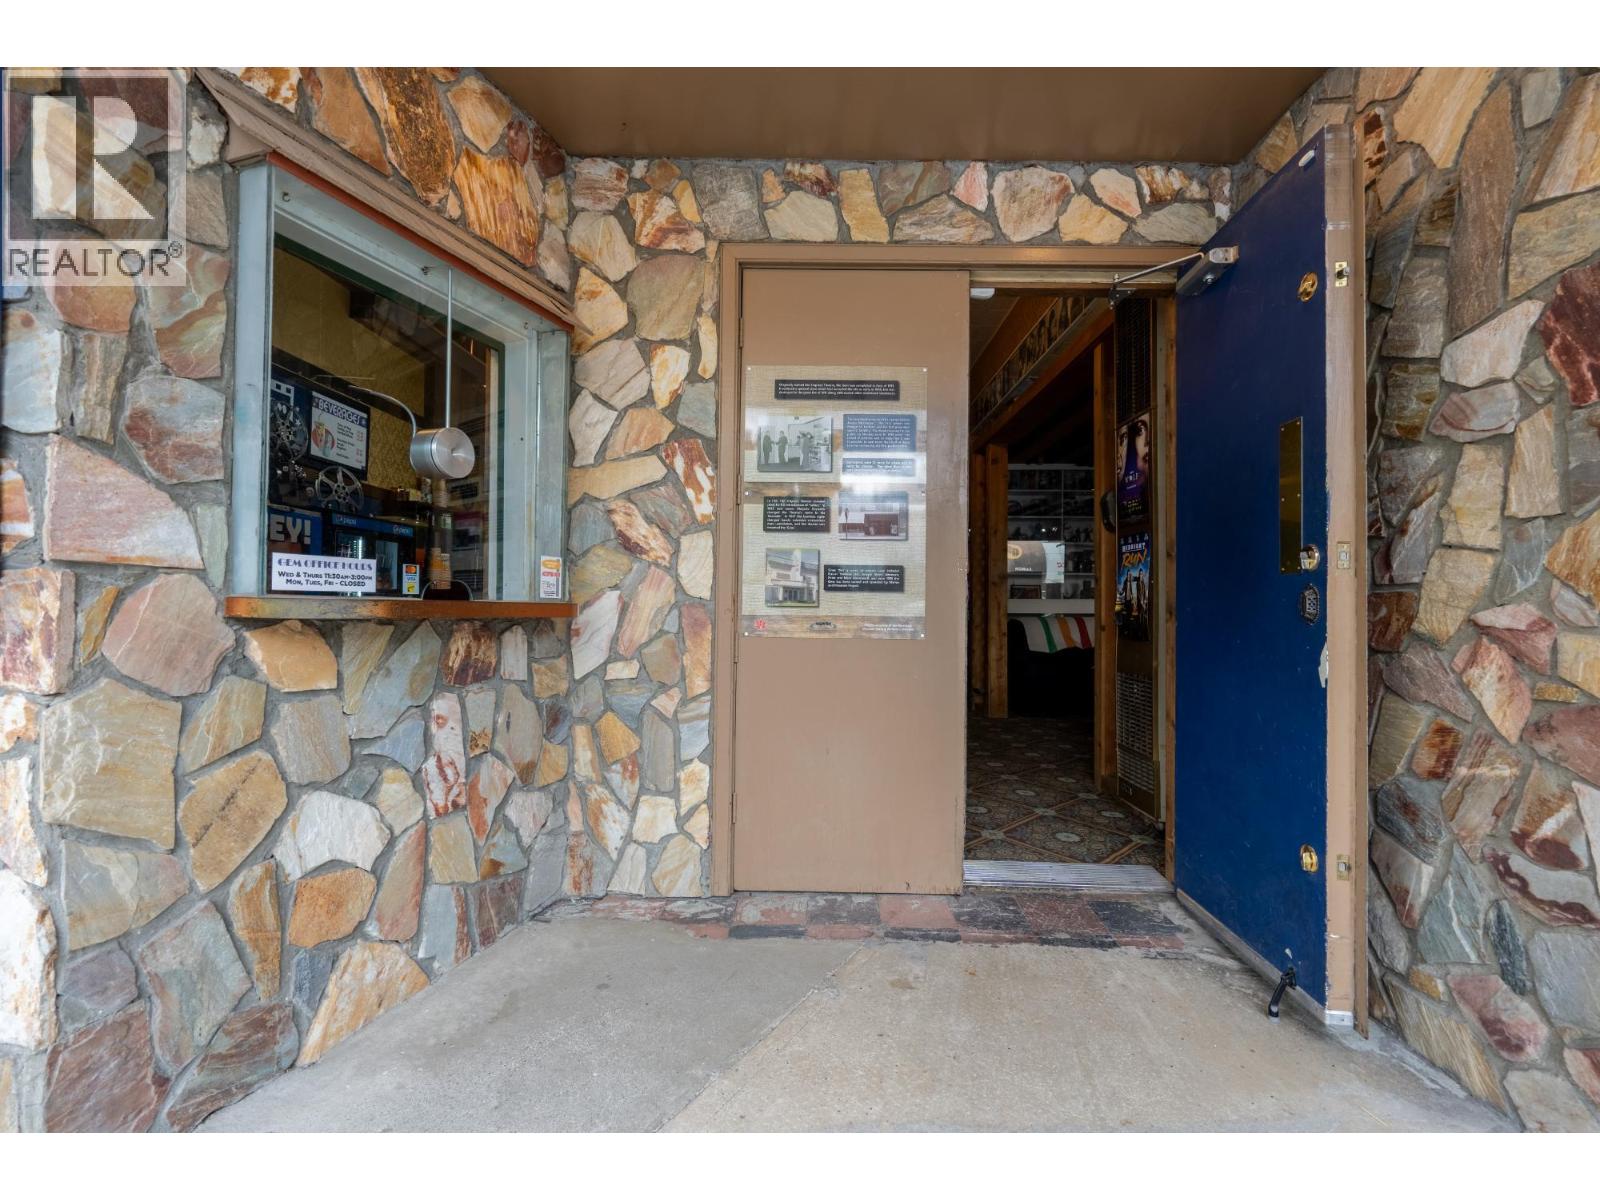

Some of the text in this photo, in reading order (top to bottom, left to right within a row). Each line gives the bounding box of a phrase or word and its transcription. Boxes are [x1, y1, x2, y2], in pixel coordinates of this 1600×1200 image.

[318, 399, 360, 424] BEVERAGES
[277, 558, 302, 567] GEM
[304, 559, 339, 569] OFFICE
[1123, 550, 1147, 567] RUN
